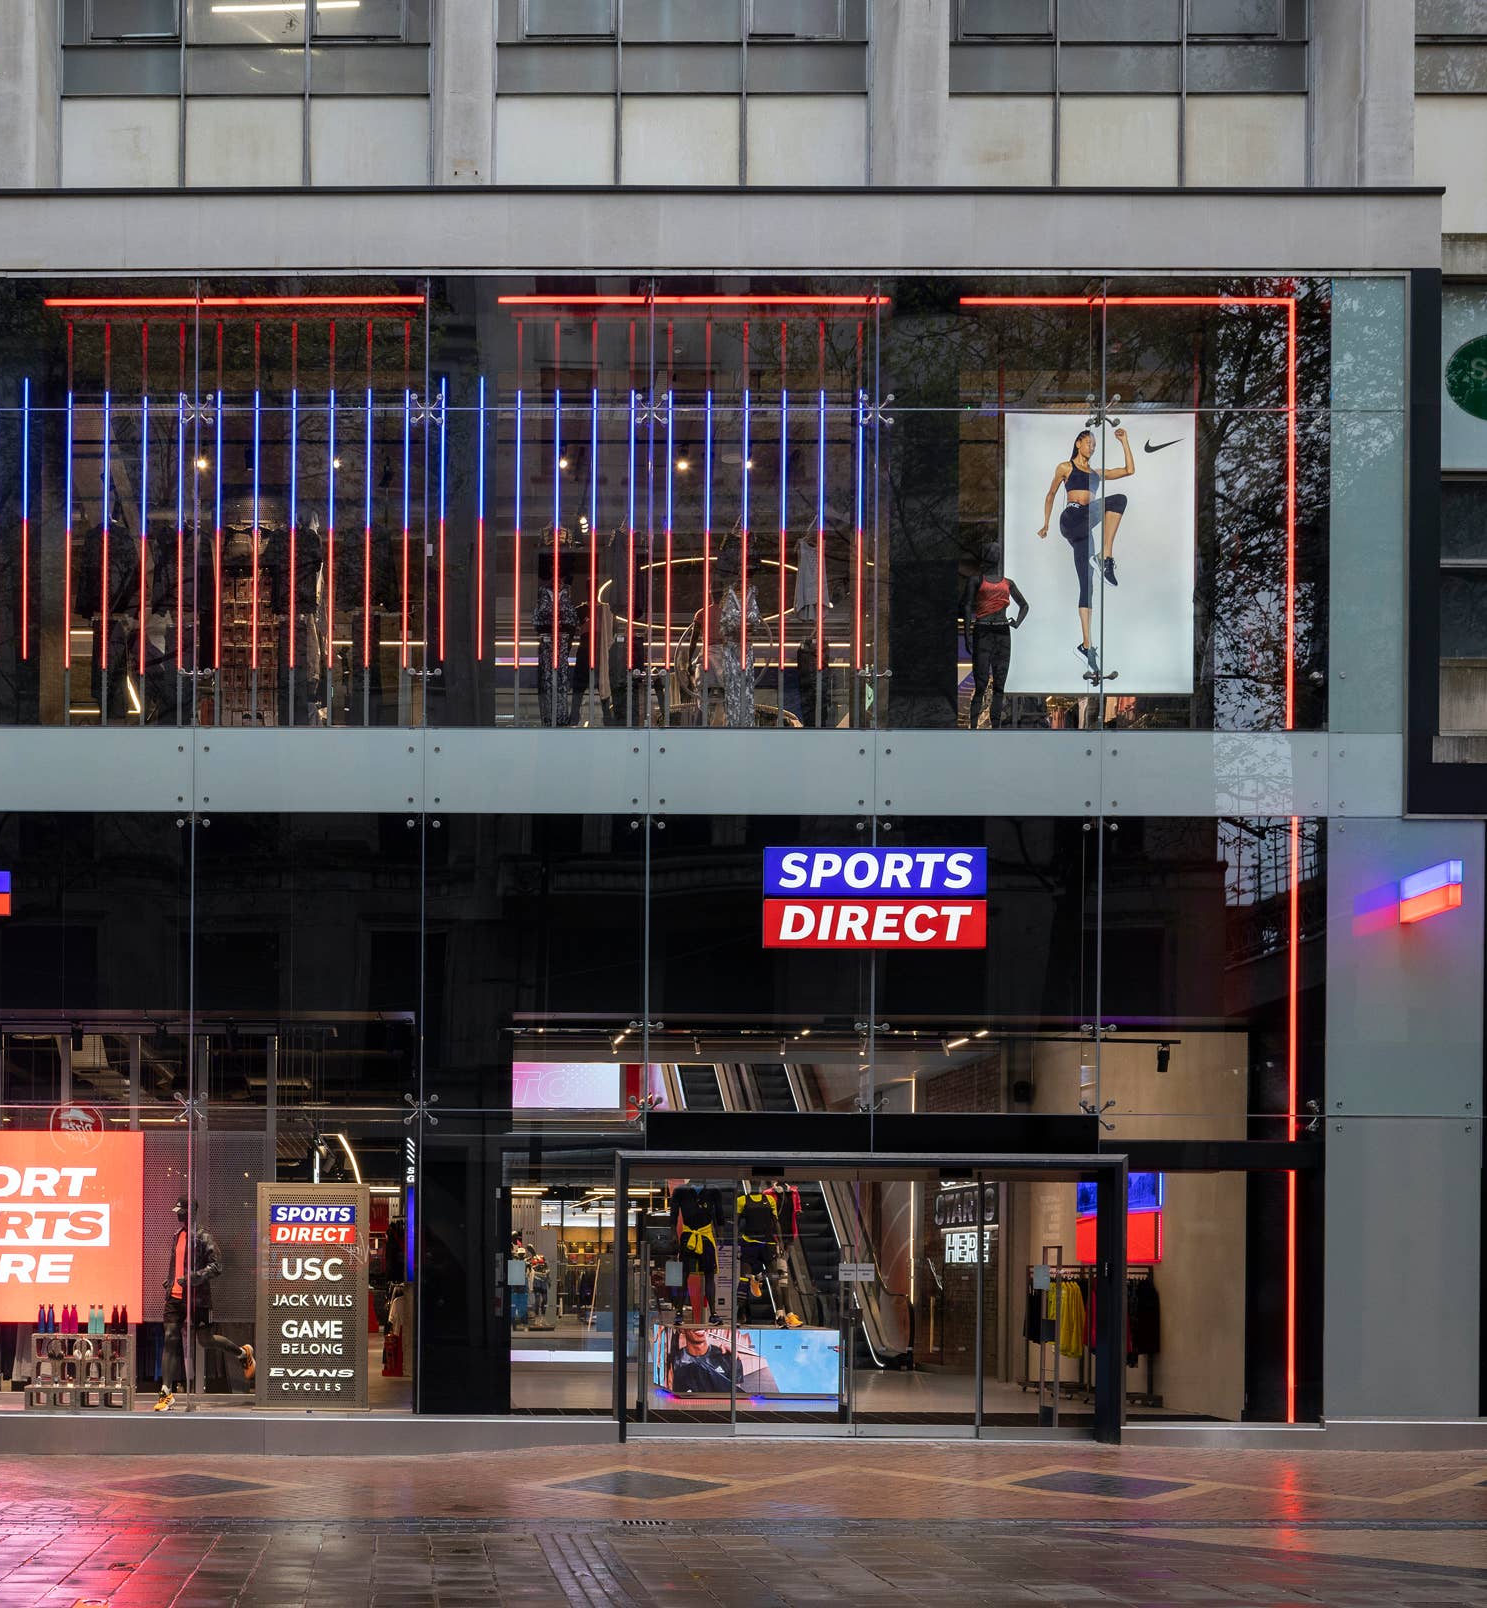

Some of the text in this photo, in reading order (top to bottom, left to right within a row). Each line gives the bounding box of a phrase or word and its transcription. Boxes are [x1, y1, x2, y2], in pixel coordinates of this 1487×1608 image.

[779, 853, 973, 888] SPORTS
[779, 905, 972, 942] DIRECT
[276, 1207, 351, 1222] SPORTS
[276, 1227, 350, 1241] DIRECT
[281, 1257, 343, 1281] USC
[273, 1295, 353, 1307] JACK WILLS
[281, 1320, 343, 1339] GAME
[281, 1344, 343, 1355] BELONG
[269, 1368, 354, 1378] EVANS
[282, 1382, 342, 1391] CYCLES
